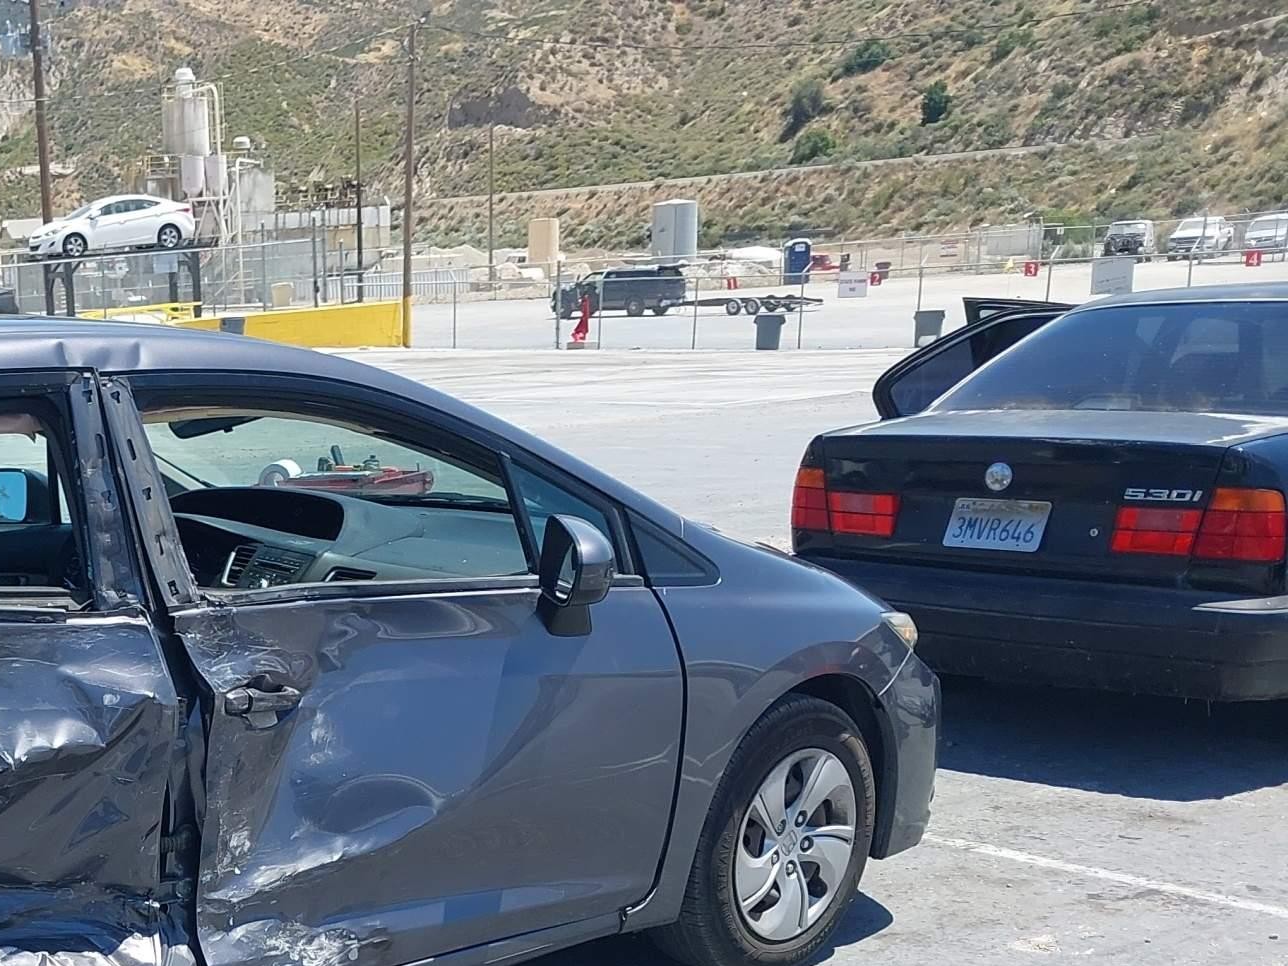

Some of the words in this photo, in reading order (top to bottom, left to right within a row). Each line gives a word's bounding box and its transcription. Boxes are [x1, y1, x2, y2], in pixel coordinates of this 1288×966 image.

[1248, 252, 1258, 266] 4
[1027, 263, 1036, 276] 3
[872, 273, 880, 284] 2
[952, 516, 1036, 543] 3MVR646
